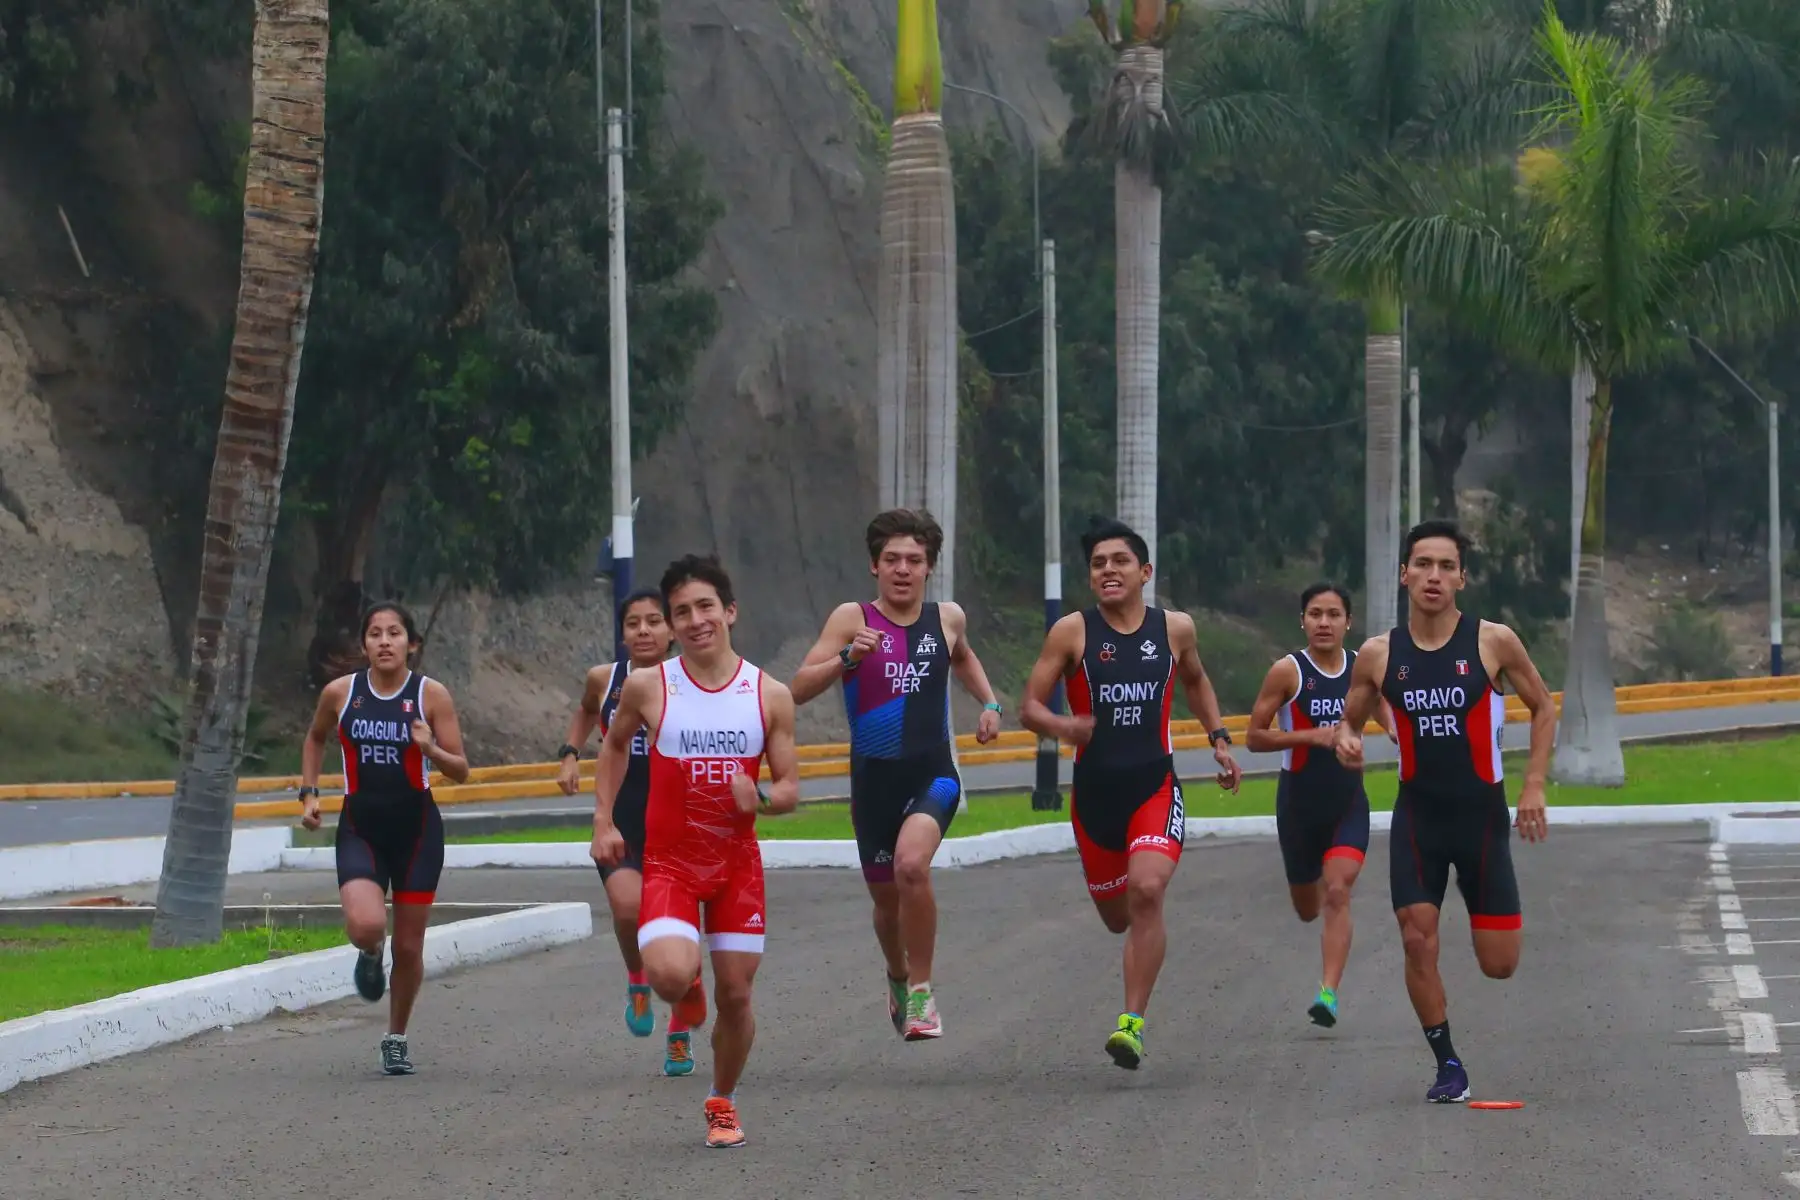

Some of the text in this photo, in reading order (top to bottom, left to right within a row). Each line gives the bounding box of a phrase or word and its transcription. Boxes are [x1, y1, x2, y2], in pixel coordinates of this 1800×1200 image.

[916, 643, 938, 654] AXT
[884, 661, 931, 678] DIAZ
[892, 677, 921, 694] PER
[1099, 681, 1159, 703] RONNY
[1403, 686, 1466, 711] BRAVO
[1113, 706, 1142, 727] PER
[1418, 714, 1461, 737] PER
[351, 718, 410, 742] COAGUILA
[679, 730, 748, 754] NAVARRO
[361, 744, 400, 764] PER
[691, 761, 738, 784] PER
[1170, 786, 1184, 842] DACLEP
[1129, 835, 1169, 852] DACLEP
[1089, 874, 1128, 892] DACLEP
